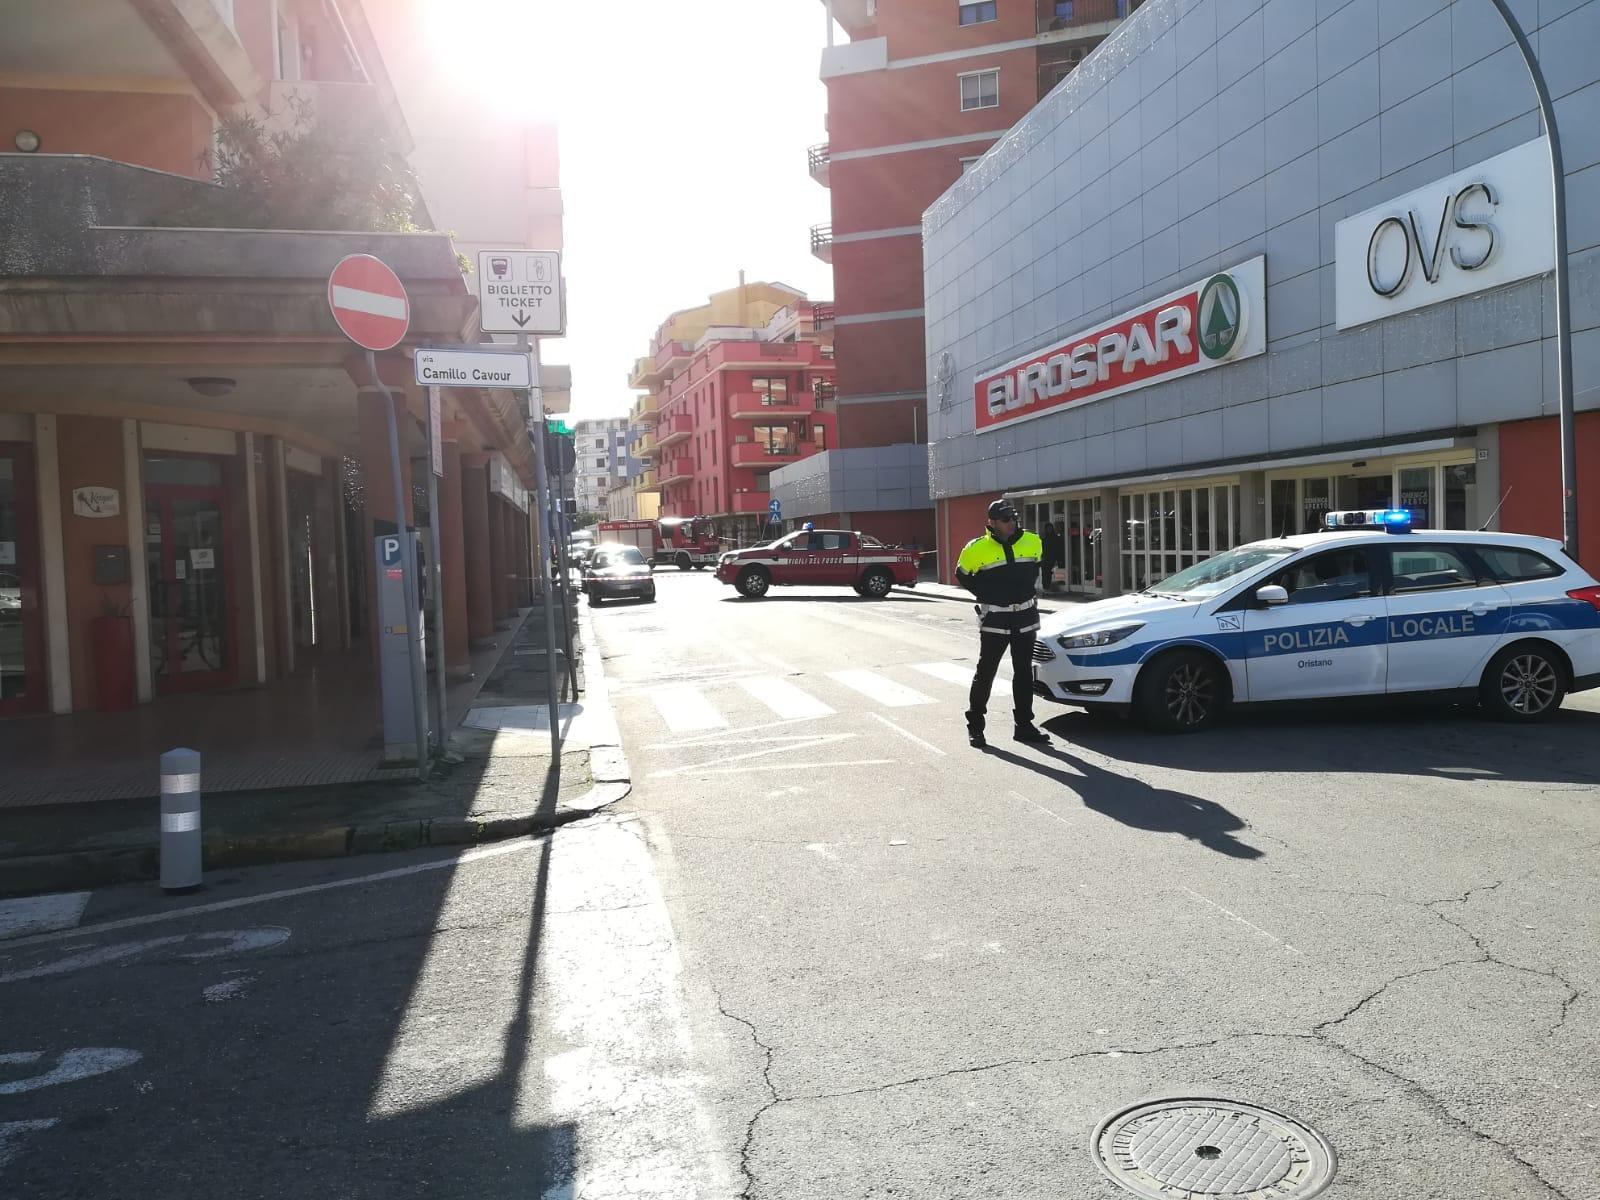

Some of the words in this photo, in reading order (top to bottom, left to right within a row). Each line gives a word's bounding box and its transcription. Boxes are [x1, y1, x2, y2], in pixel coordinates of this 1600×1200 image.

[1366, 182, 1500, 298] OVS
[487, 284, 552, 296] BIGLIETTO
[498, 297, 543, 308] TICKET
[422, 355, 434, 363] via
[987, 304, 1193, 416] EUROSPAR
[423, 367, 467, 381] Camillo
[472, 369, 512, 382] Cavour
[384, 539, 399, 561] P
[1390, 615, 1475, 639] LOCALE
[1263, 626, 1350, 652] POLIZIA
[1297, 658, 1333, 669] Oristano
